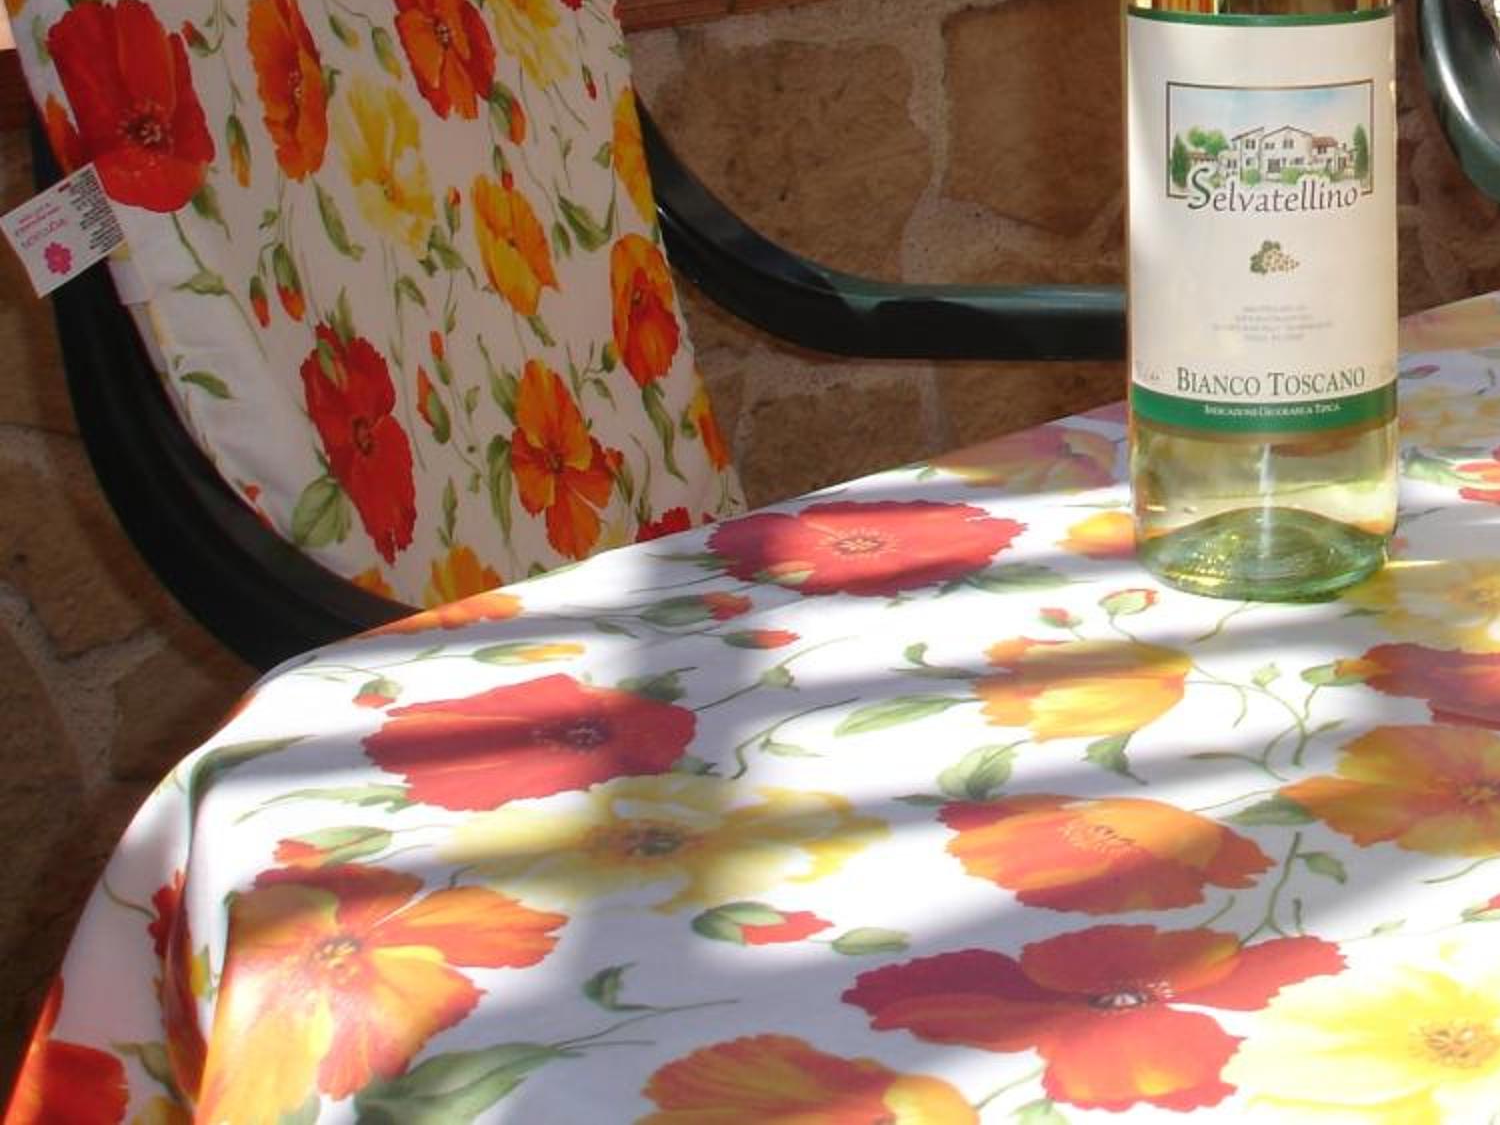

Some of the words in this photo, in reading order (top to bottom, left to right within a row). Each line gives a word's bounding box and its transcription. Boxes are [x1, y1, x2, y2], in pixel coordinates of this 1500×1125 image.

[1187, 167, 1358, 213] Selvatellino
[1176, 366, 1262, 396] BIANCO
[1267, 365, 1366, 396] TOSCANO
